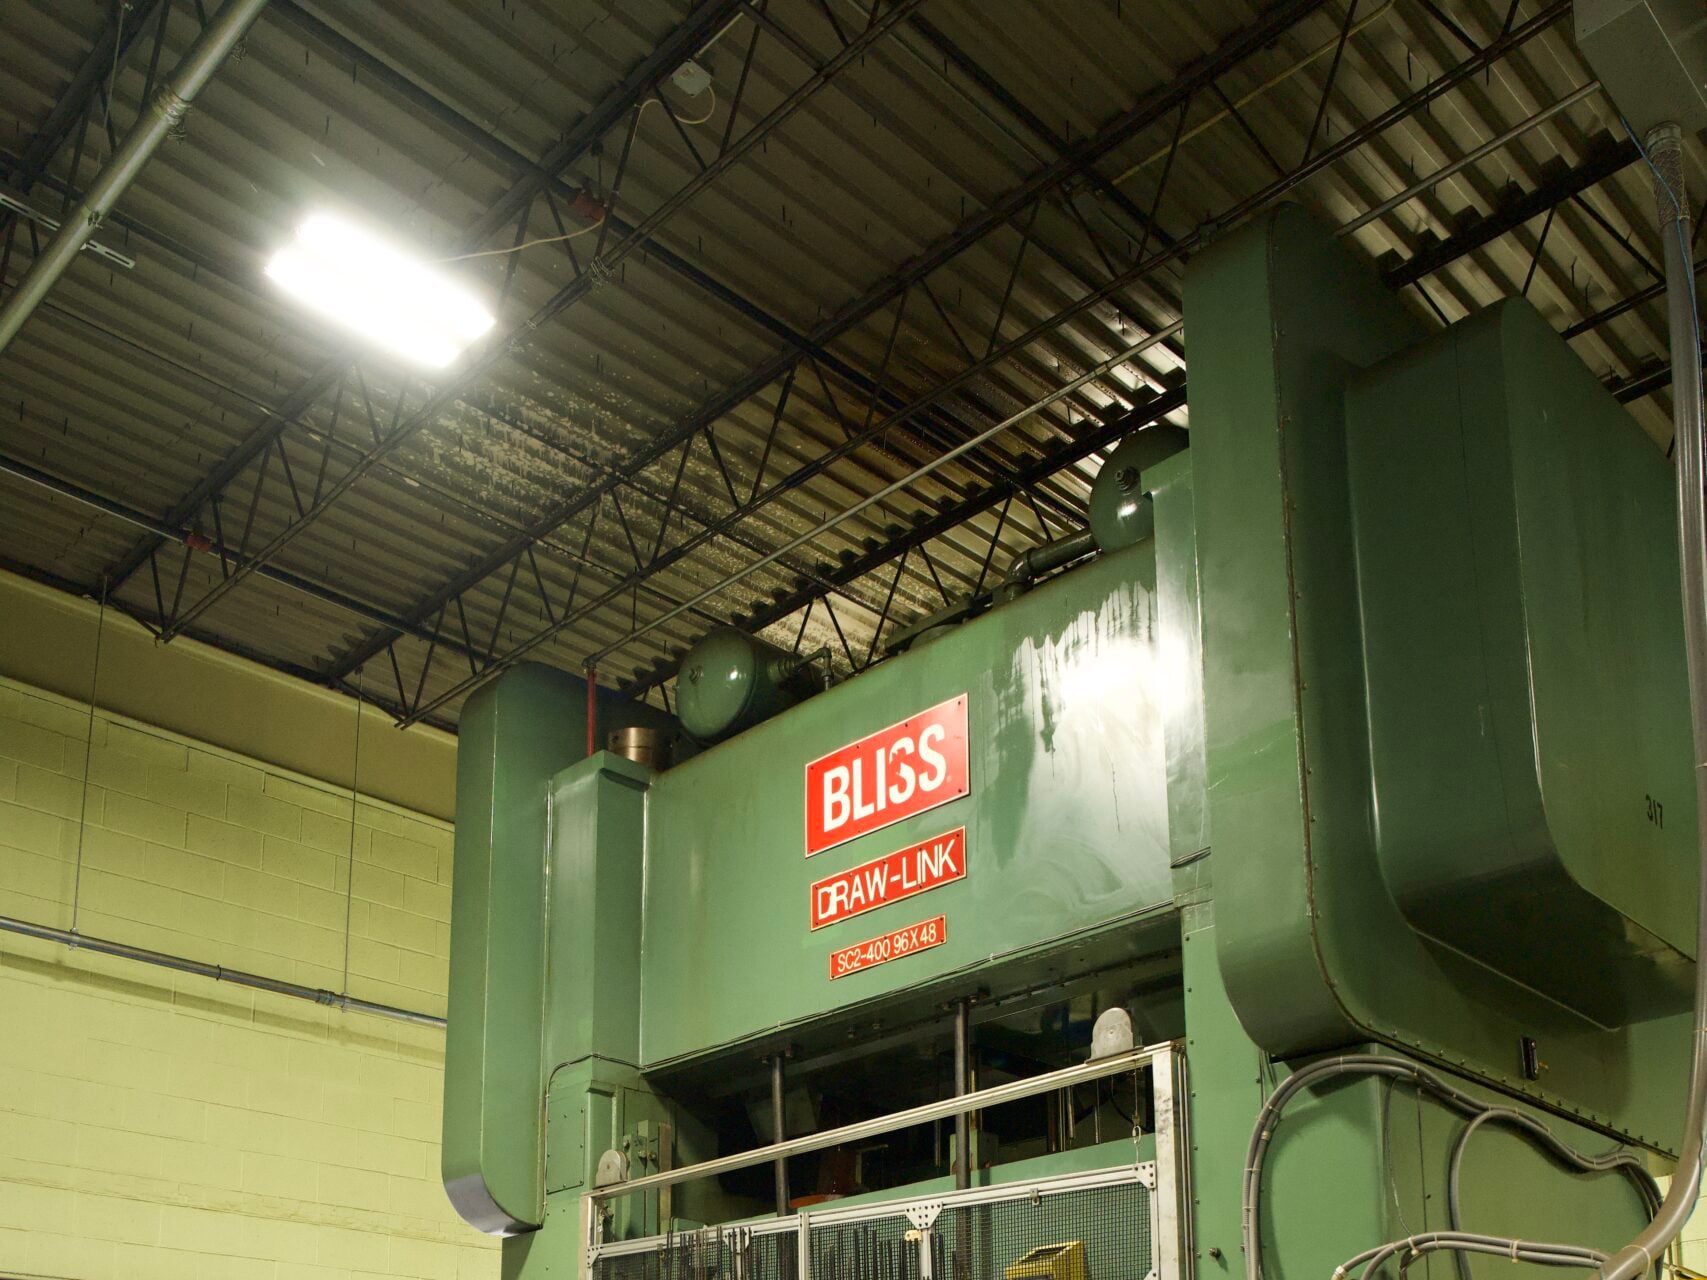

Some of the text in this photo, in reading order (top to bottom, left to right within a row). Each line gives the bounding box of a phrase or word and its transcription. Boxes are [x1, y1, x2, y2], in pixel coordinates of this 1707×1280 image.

[823, 722, 947, 833] BLISS
[817, 838, 957, 921] DRAW-LINK
[837, 939, 891, 972] SC2-400
